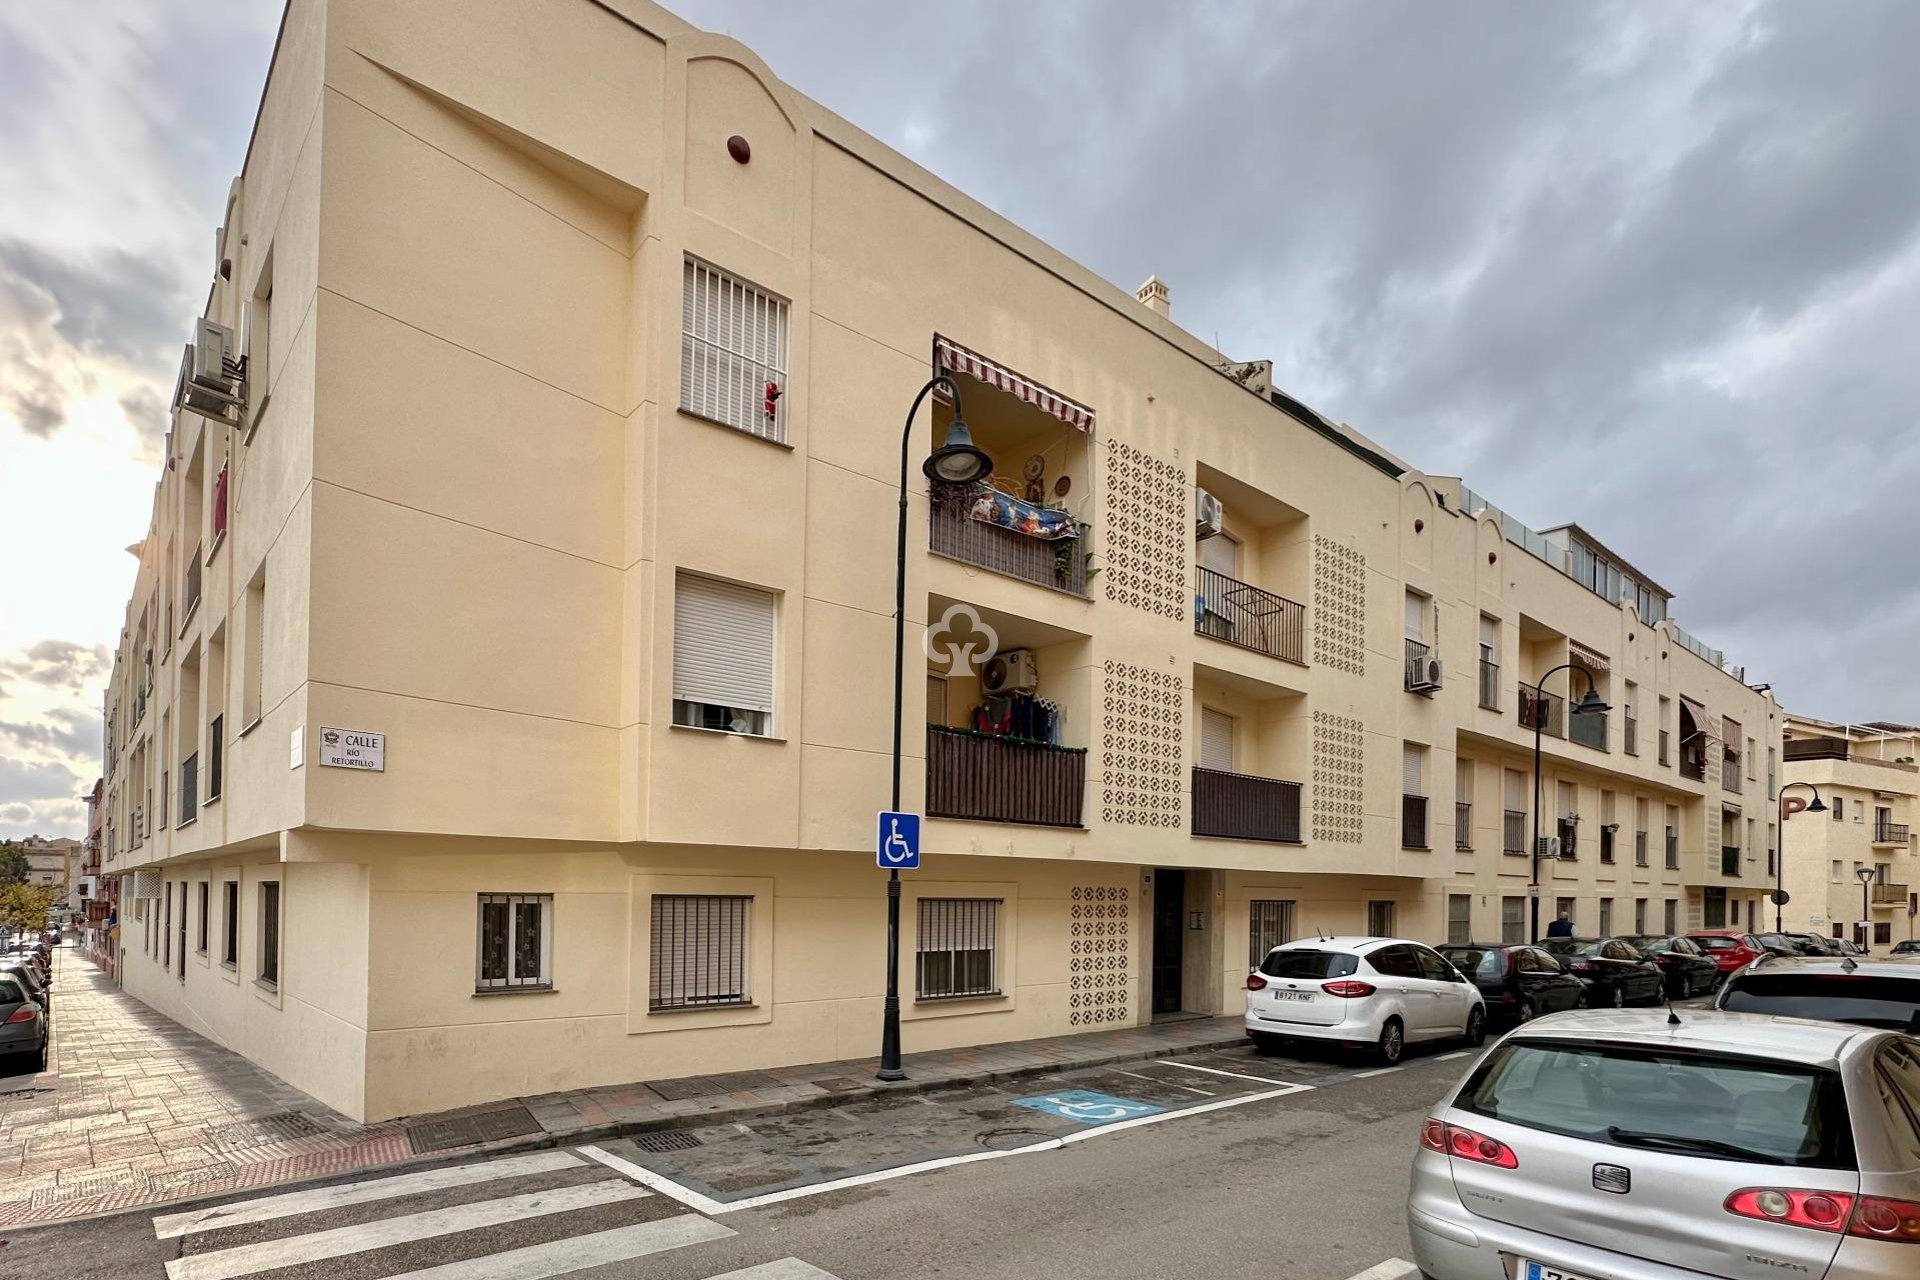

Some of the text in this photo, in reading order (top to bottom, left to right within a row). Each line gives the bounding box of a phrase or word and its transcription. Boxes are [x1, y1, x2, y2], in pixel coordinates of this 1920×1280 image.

[345, 735, 379, 748] CALLE
[346, 748, 359, 756] RÍO
[331, 757, 374, 768] RETORTILLO
[1782, 797, 1806, 820] P
[1279, 991, 1296, 1000] 8121
